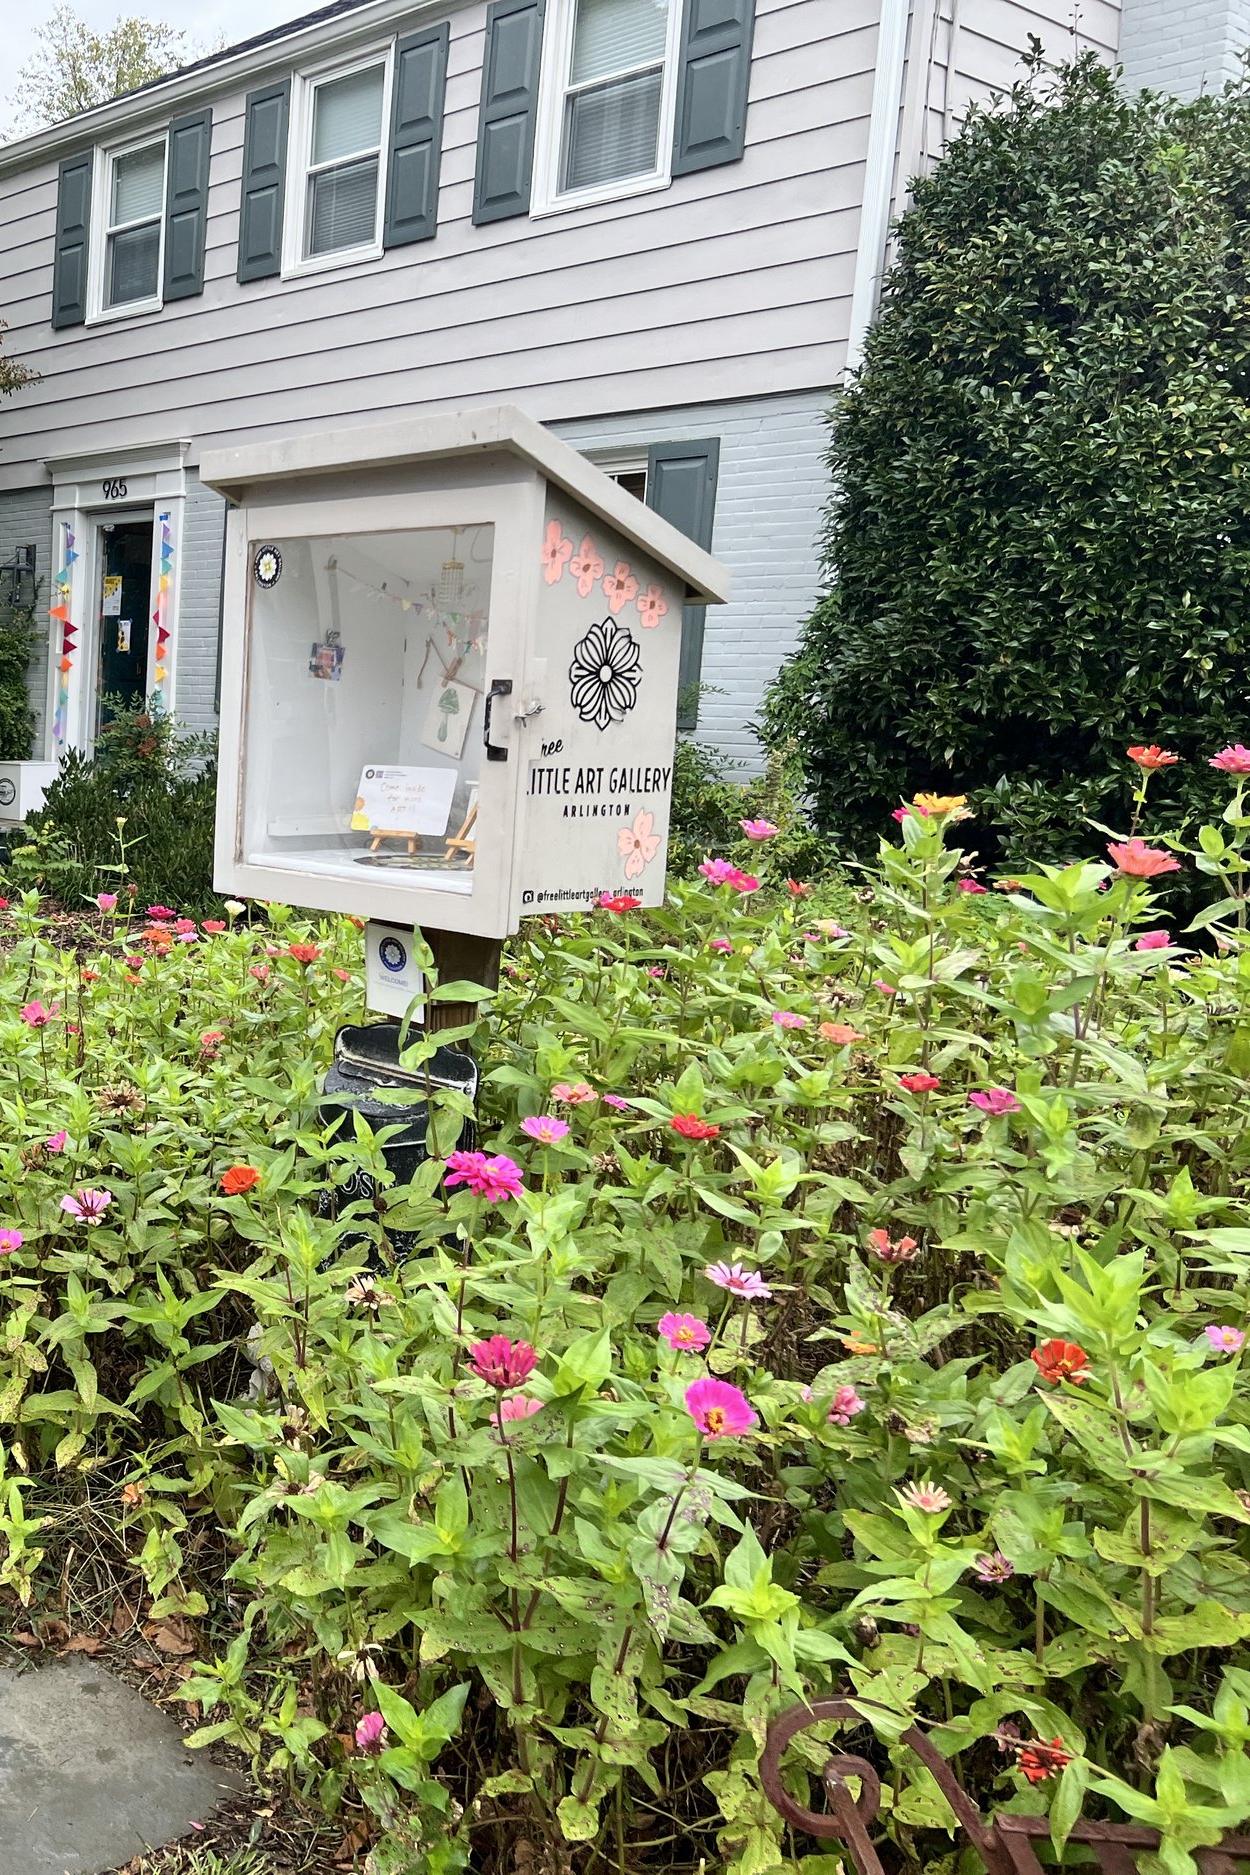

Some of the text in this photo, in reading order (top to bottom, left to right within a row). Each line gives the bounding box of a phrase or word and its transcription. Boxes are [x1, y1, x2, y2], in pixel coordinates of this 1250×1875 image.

[102, 479, 128, 500] 965
[540, 738, 564, 758] ree
[526, 767, 671, 795] ITTLE ART GALLERY
[563, 804, 630, 818] ARLINGTON
[536, 887, 644, 903] @freelittleartgaller_arlngton
